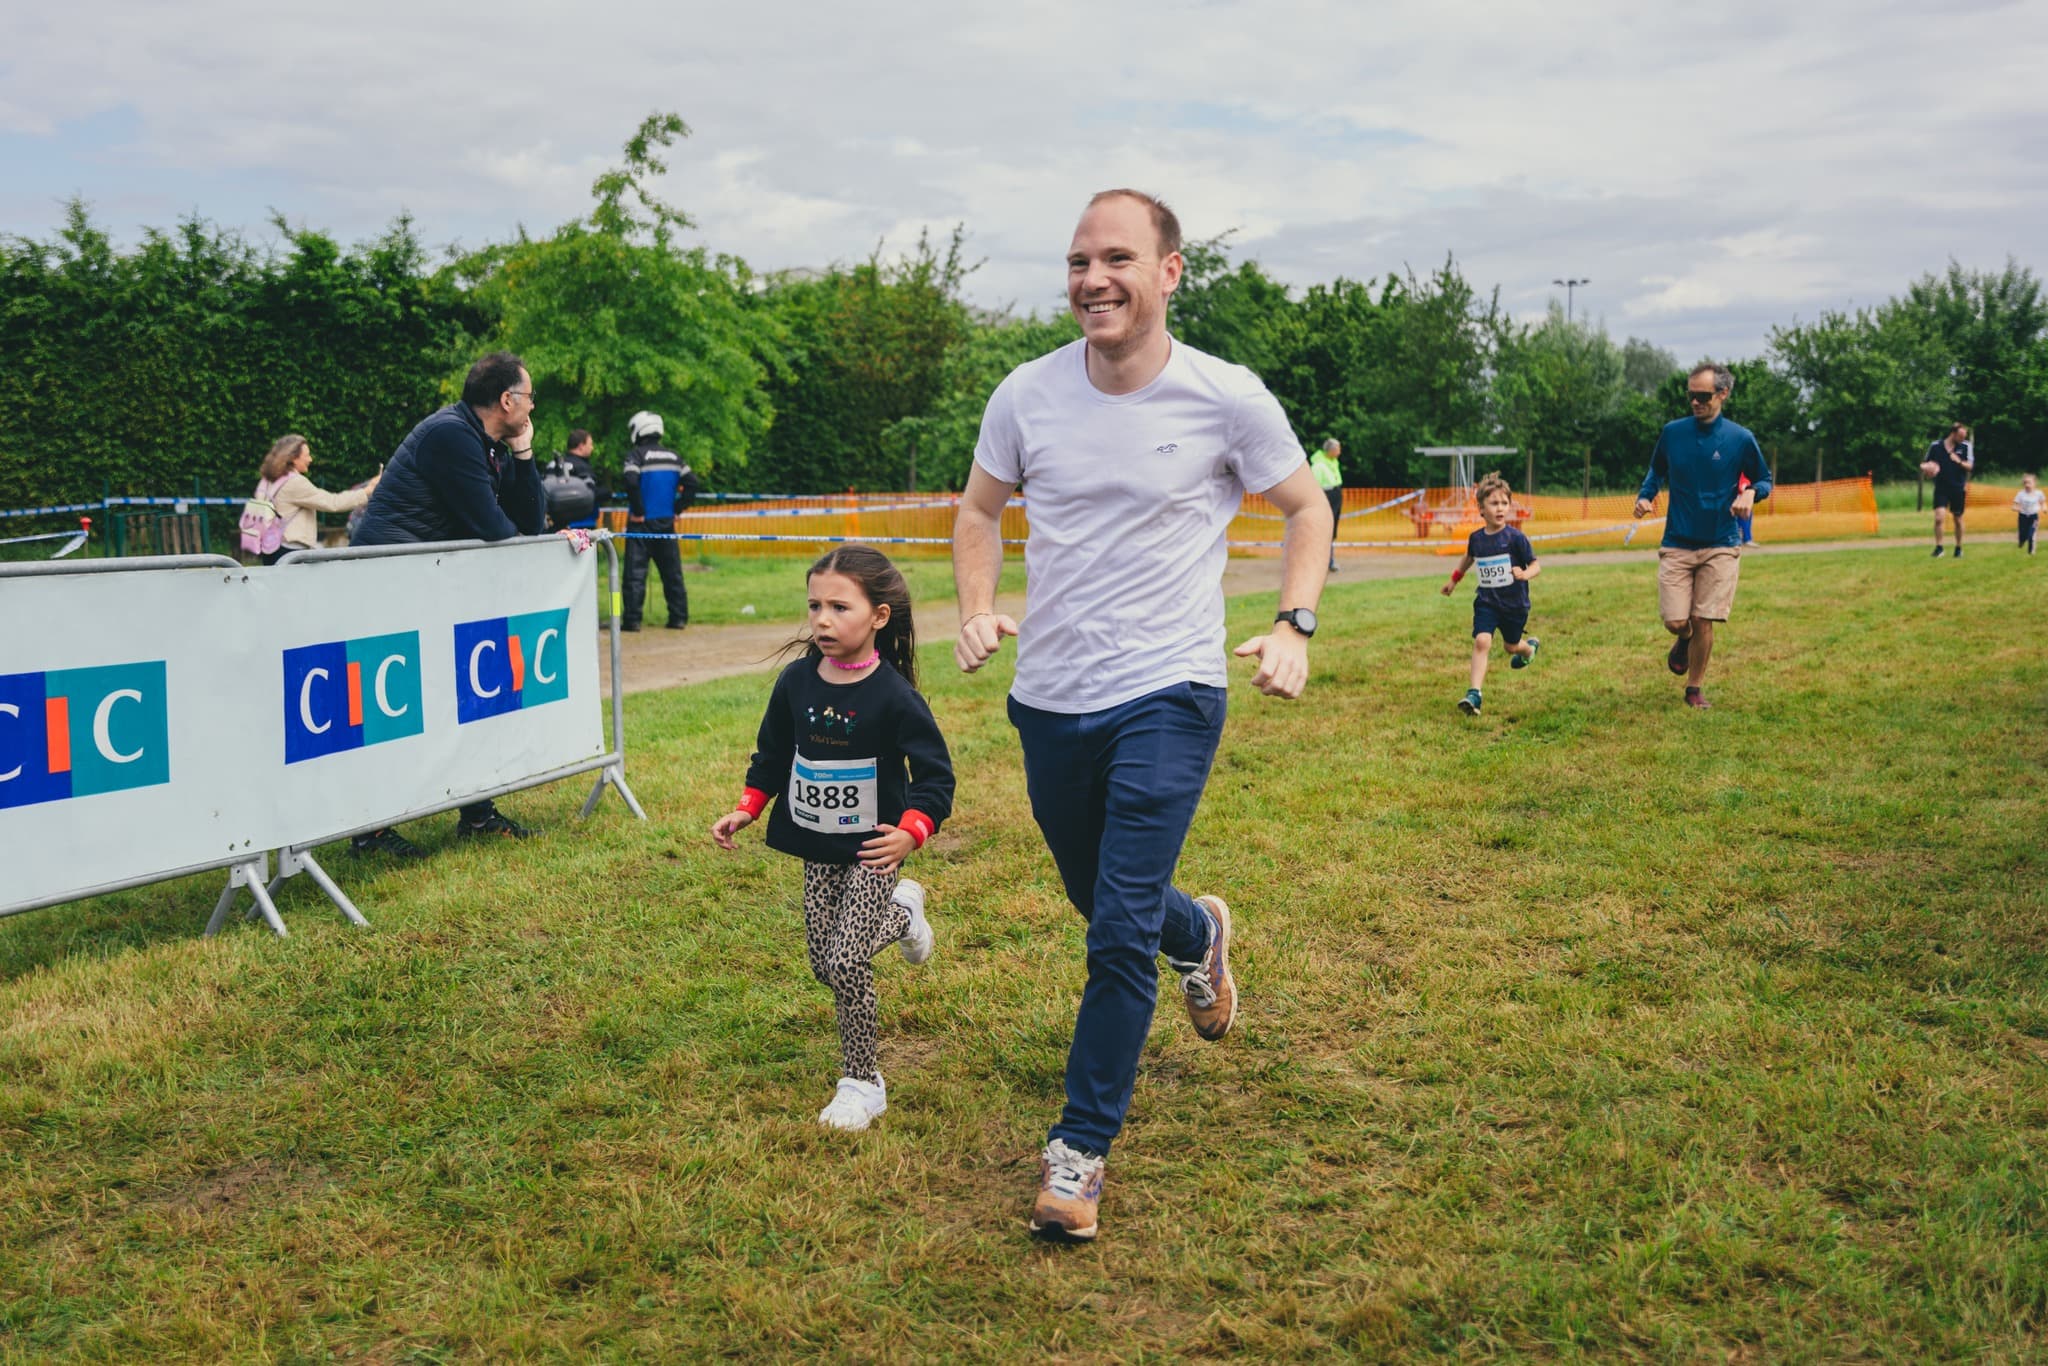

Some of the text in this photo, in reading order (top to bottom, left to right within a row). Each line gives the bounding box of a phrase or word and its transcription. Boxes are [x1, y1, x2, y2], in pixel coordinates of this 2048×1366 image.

[1479, 566, 1505, 578] 1959
[469, 628, 558, 698] CIC
[299, 654, 408, 734] CIC
[795, 780, 859, 809] 1888
[840, 815, 858, 824] CIC
